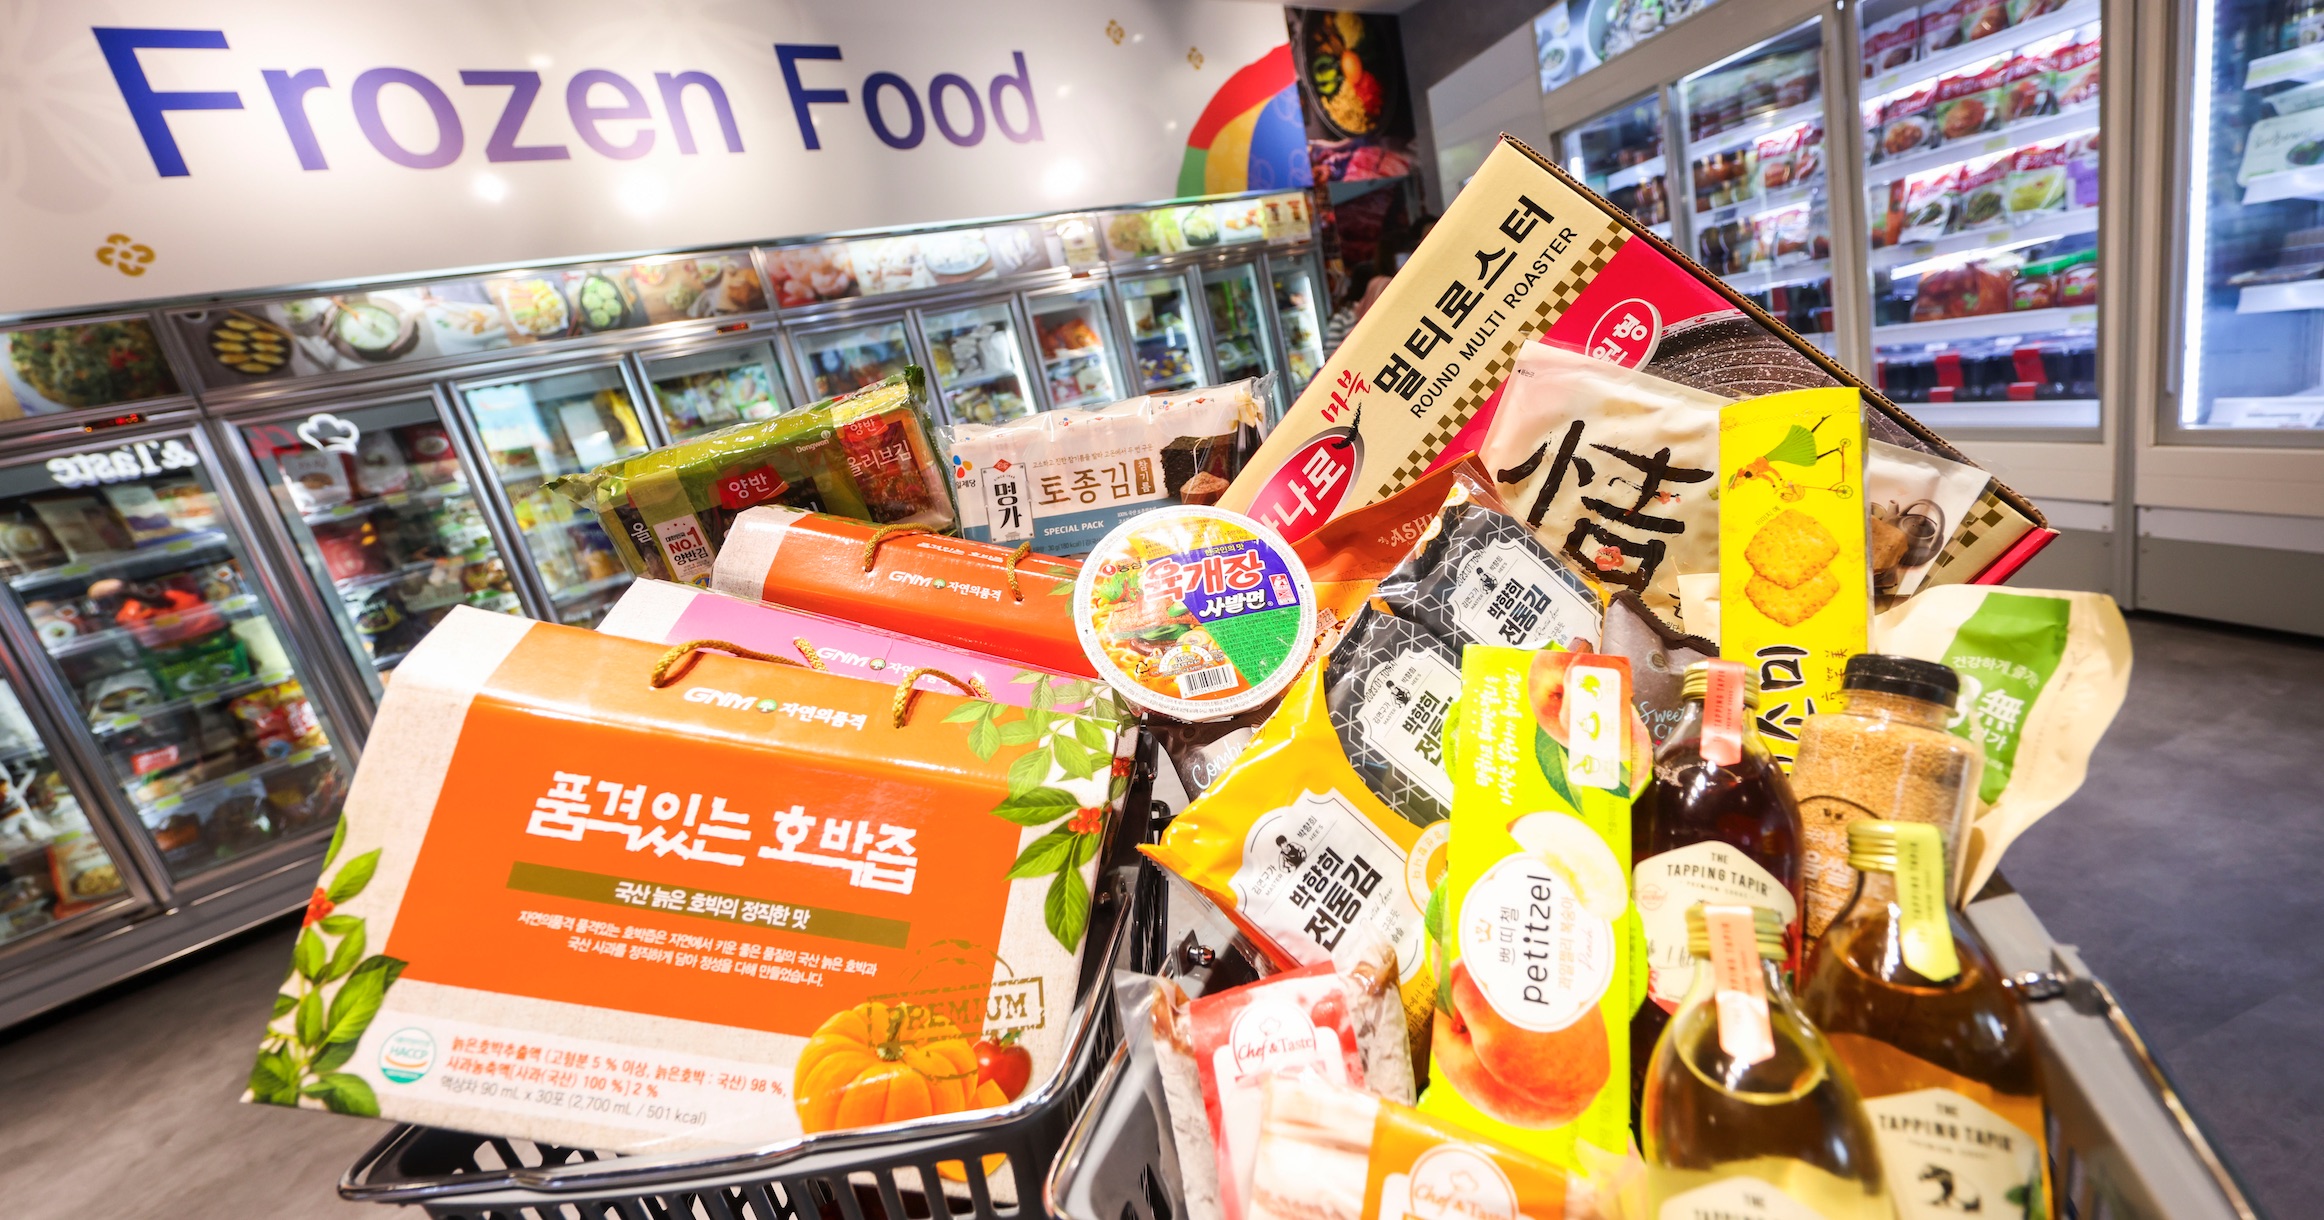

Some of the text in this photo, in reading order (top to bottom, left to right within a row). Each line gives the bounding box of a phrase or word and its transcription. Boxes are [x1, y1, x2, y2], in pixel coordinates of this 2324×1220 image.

[92, 27, 1044, 177] Frozen Food
[1373, 194, 1555, 401] 멀티로스터
[1410, 226, 1578, 418] ROUND MULTI ROASTER
[849, 416, 879, 438] 양반
[795, 437, 832, 455] Dongwon
[845, 441, 914, 477] 올리브김
[727, 472, 770, 500] 양반
[1038, 462, 1130, 506] 토종김
[1137, 460, 1152, 493] 참기름
[994, 482, 1022, 529] 명가
[668, 525, 704, 554] NO.1
[1043, 519, 1104, 536] SPECIAL PACK
[673, 545, 712, 567] 양반김
[1235, 544, 1245, 553] 맛
[1489, 555, 1504, 572] 박향희
[889, 569, 933, 588] GNM
[1117, 558, 1142, 574] 농심
[1143, 549, 1265, 602] 육개장
[946, 580, 1003, 602] 자연의품격
[1199, 588, 1267, 619] 사발면
[1470, 593, 1486, 610] MASTER
[1485, 578, 1525, 620] 박향희
[1498, 584, 1552, 645] 전통김
[815, 646, 869, 668] GNM
[1952, 655, 2011, 676] 건강하게
[1401, 666, 1418, 684] 박향희
[683, 686, 751, 712] GNM
[1402, 690, 1441, 735] 박향희
[1714, 695, 1723, 727] TAPPING
[779, 701, 868, 731] 자연의품격
[1382, 708, 1398, 725] MASTER
[1496, 720, 1518, 763] 복숭아가
[525, 770, 918, 895] 품격있는 호박즙
[1250, 815, 1319, 896] 김연구가 박향희
[1264, 825, 1325, 897] MASTER HEE'S
[1711, 851, 1729, 864] THE
[1288, 846, 1345, 910] 박향희
[1667, 864, 1770, 897] TAPPING TAPIR
[614, 882, 811, 930] 국산 늙은 호박의 정직한 맛
[1303, 854, 1384, 952] 전통김
[517, 911, 877, 977] 자연의품격 품격있는 호박즙은 자연에서 키운 좋은 품질의 국산 늙은 호박과
[1497, 905, 1519, 965] 쁘띠첼
[1519, 874, 1555, 1004] petitzel
[567, 936, 824, 987] 국산 사과를 정직하게 담아 정성을 다해 만들었습니다.
[886, 992, 1028, 1033] PREMIUM
[389, 1045, 428, 1061] HACCP
[451, 1035, 541, 1061] 늙은호박추출액
[544, 1047, 589, 1071] (고형분
[591, 1057, 600, 1069] 5
[606, 1057, 617, 1071] %
[622, 1059, 650, 1079] 이상,
[655, 1065, 704, 1086] 늙은호박
[717, 1072, 746, 1092] 국산)
[750, 1077, 766, 1091] 98
[769, 1079, 787, 1098] %,
[1237, 1035, 1314, 1065] Chef & Taste
[441, 1075, 477, 1094] 액상차
[481, 1082, 498, 1095] 90
[500, 1086, 519, 1100] mL
[523, 1092, 532, 1101] x
[537, 1090, 565, 1107] 30포
[567, 1094, 609, 1113] (2,700
[613, 1101, 632, 1115] mL
[646, 1106, 670, 1121] 501
[674, 1109, 707, 1126] kcal)
[582, 1075, 607, 1090] 100
[612, 1078, 629, 1097] %]
[634, 1083, 642, 1095] 2
[646, 1084, 658, 1098] %
[1936, 1102, 1959, 1118] THE
[1878, 1114, 1957, 1140] TAPPING
[1965, 1127, 2013, 1154] TAPIR
[1744, 1191, 1766, 1209] THE
